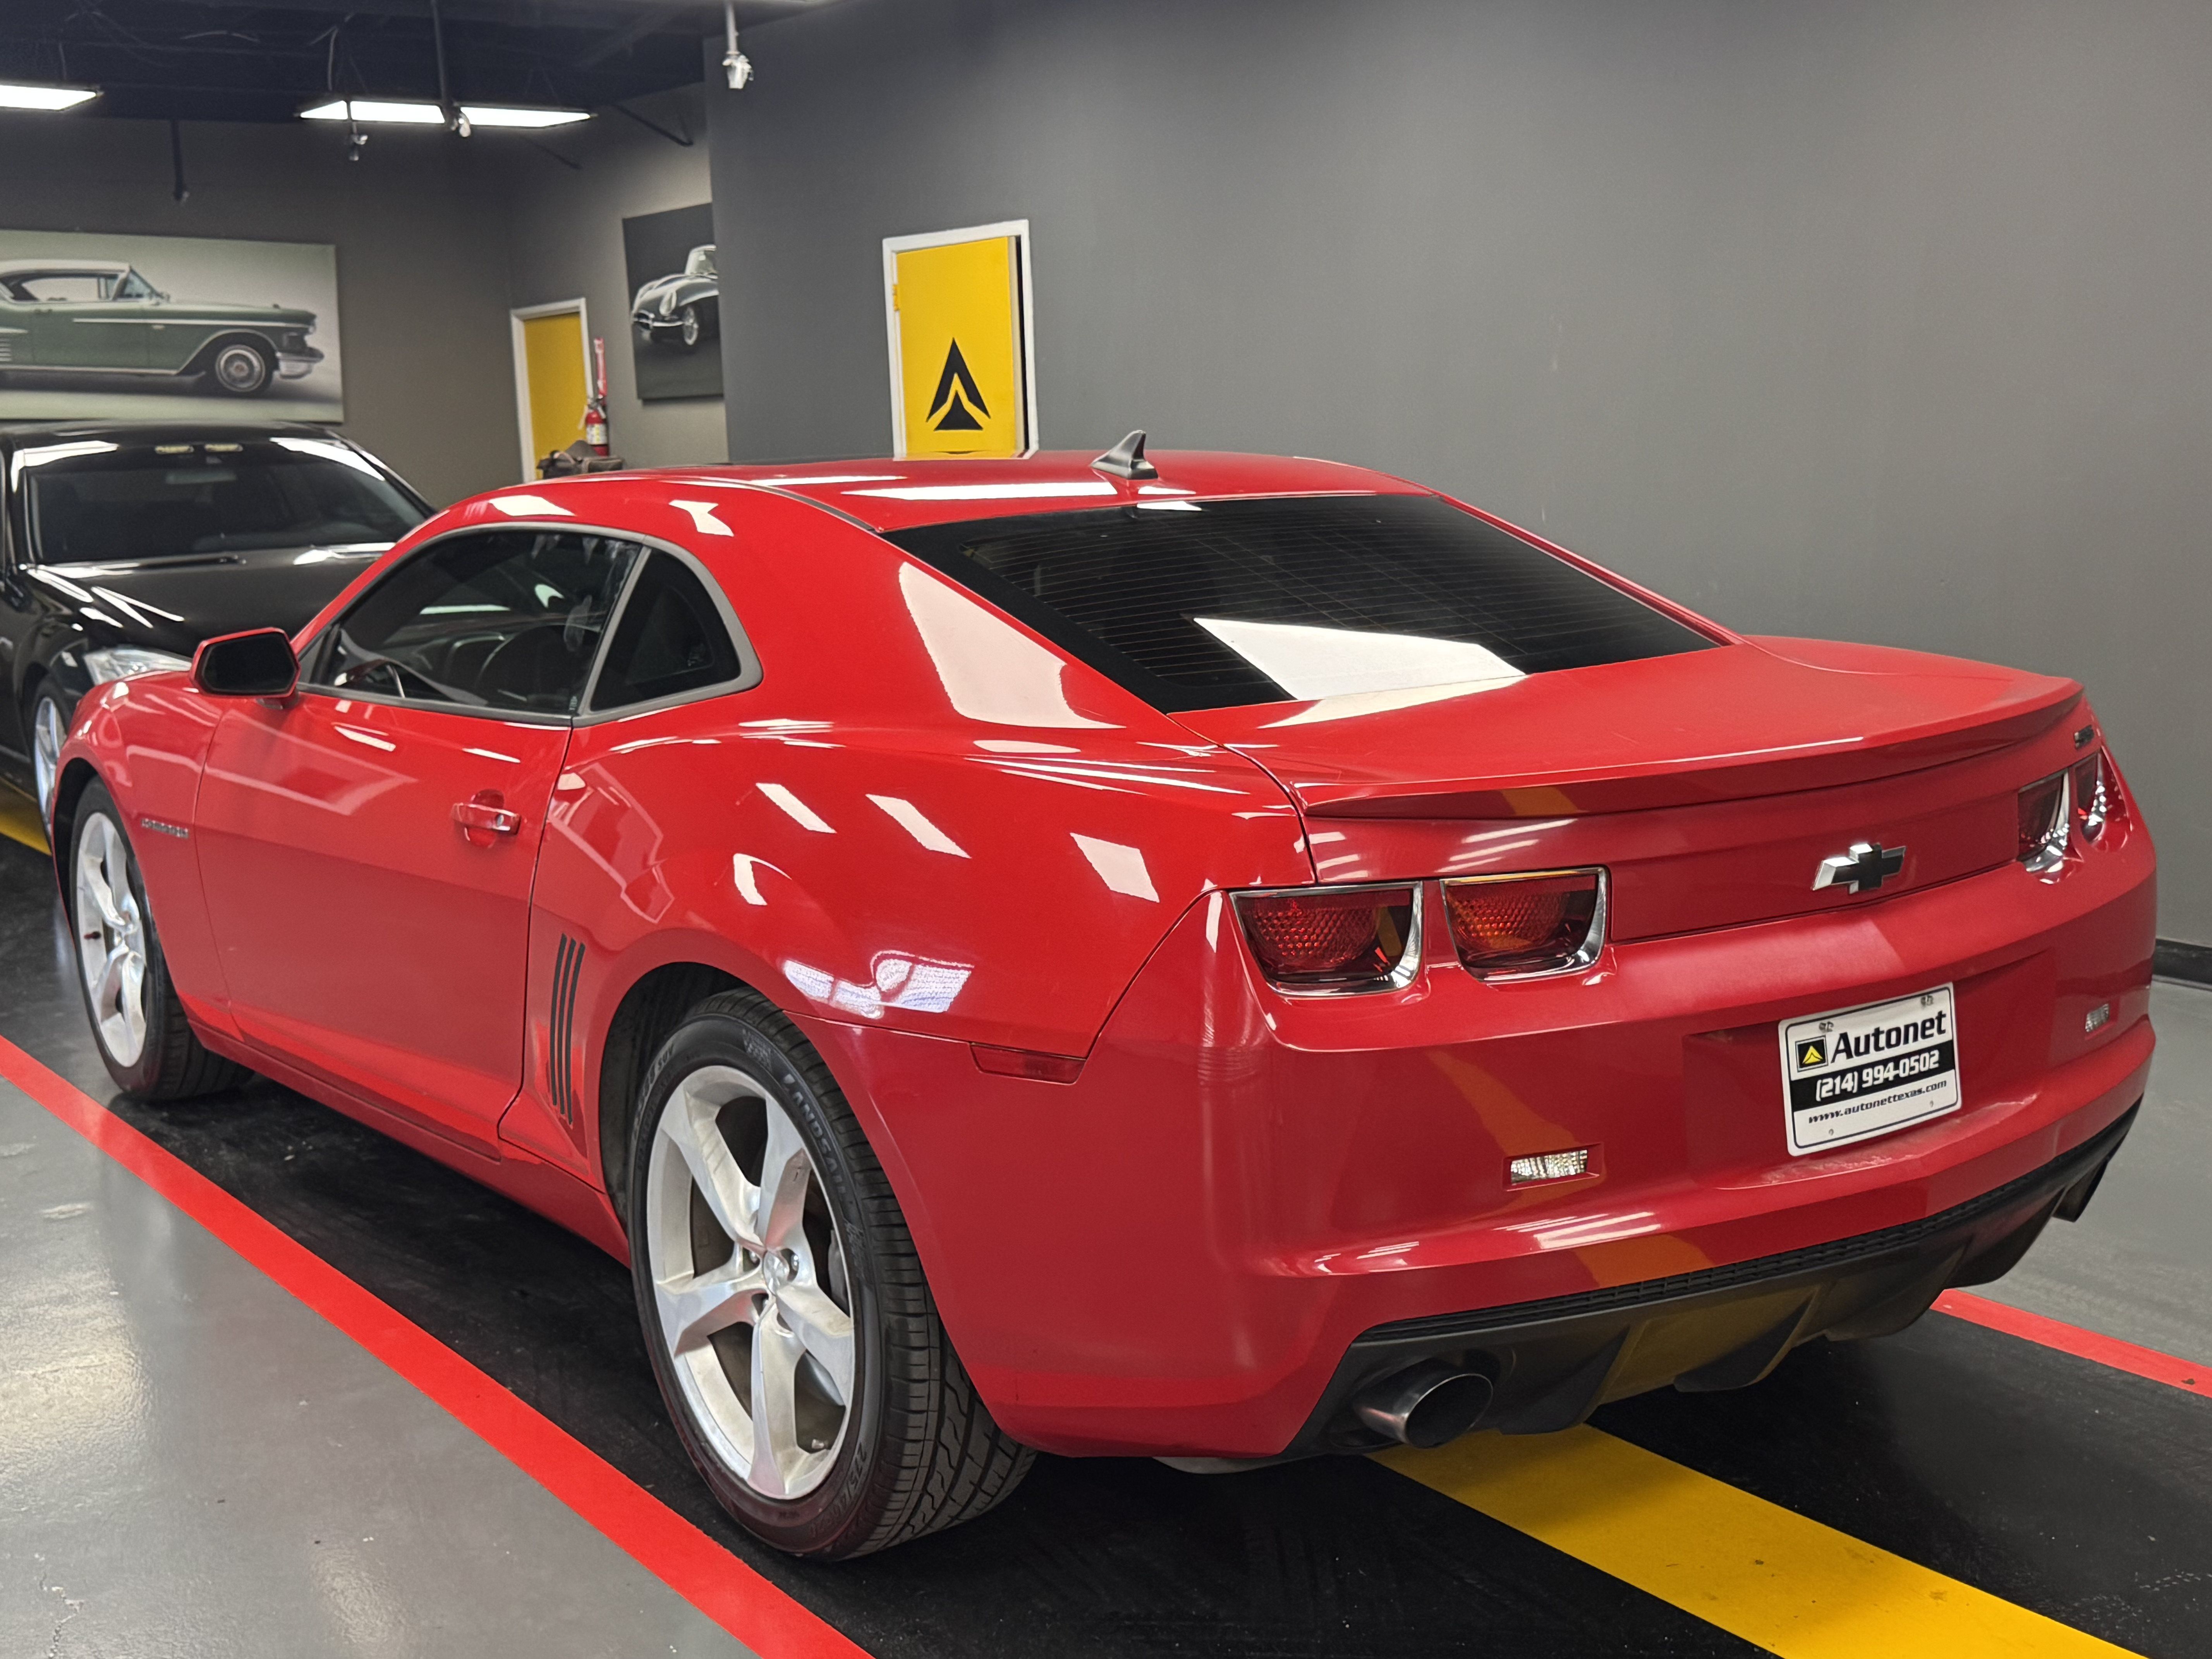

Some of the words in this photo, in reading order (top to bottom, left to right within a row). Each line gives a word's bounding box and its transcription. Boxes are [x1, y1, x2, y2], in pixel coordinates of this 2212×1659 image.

[1831, 1010, 1946, 1063] Autonet
[1808, 1080, 1947, 1124] www.autonettexas.com
[1816, 1071, 1858, 1102] (214)
[1862, 1049, 1940, 1088] 994-0502
